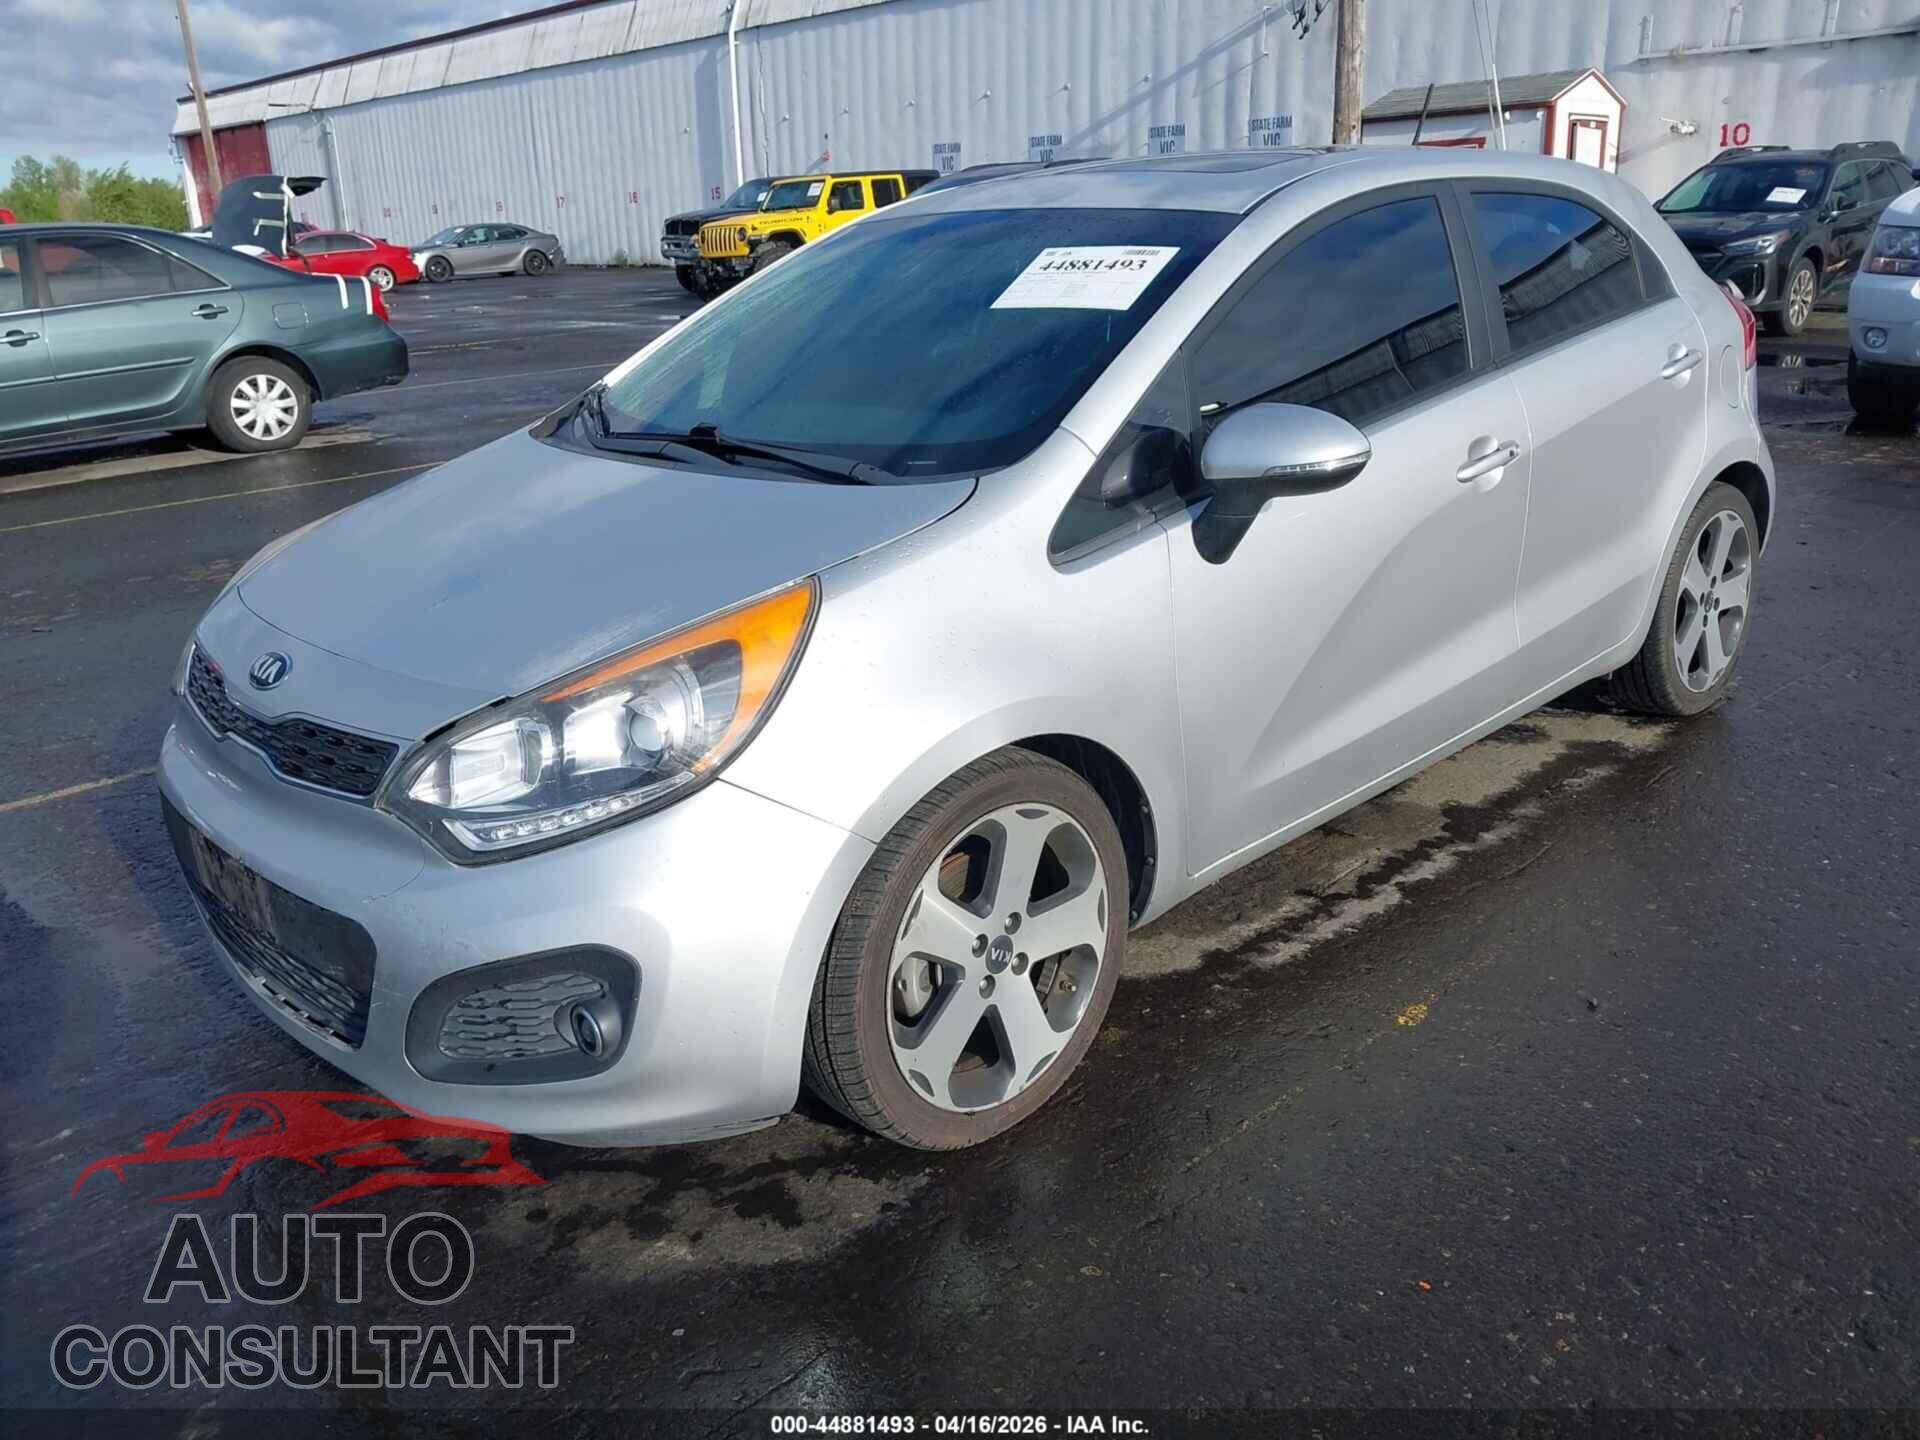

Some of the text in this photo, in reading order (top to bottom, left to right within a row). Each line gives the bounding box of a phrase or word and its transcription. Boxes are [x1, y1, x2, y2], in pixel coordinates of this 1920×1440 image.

[1252, 115, 1293, 131] STATE FARM
[1150, 124, 1186, 138] STATE FARM
[1720, 123, 1750, 147] 10
[942, 156, 954, 171] VIC
[710, 186, 721, 200] 15
[556, 196, 566, 209] 17
[1039, 259, 1147, 271] 44881493
[991, 947, 1012, 963] KIA
